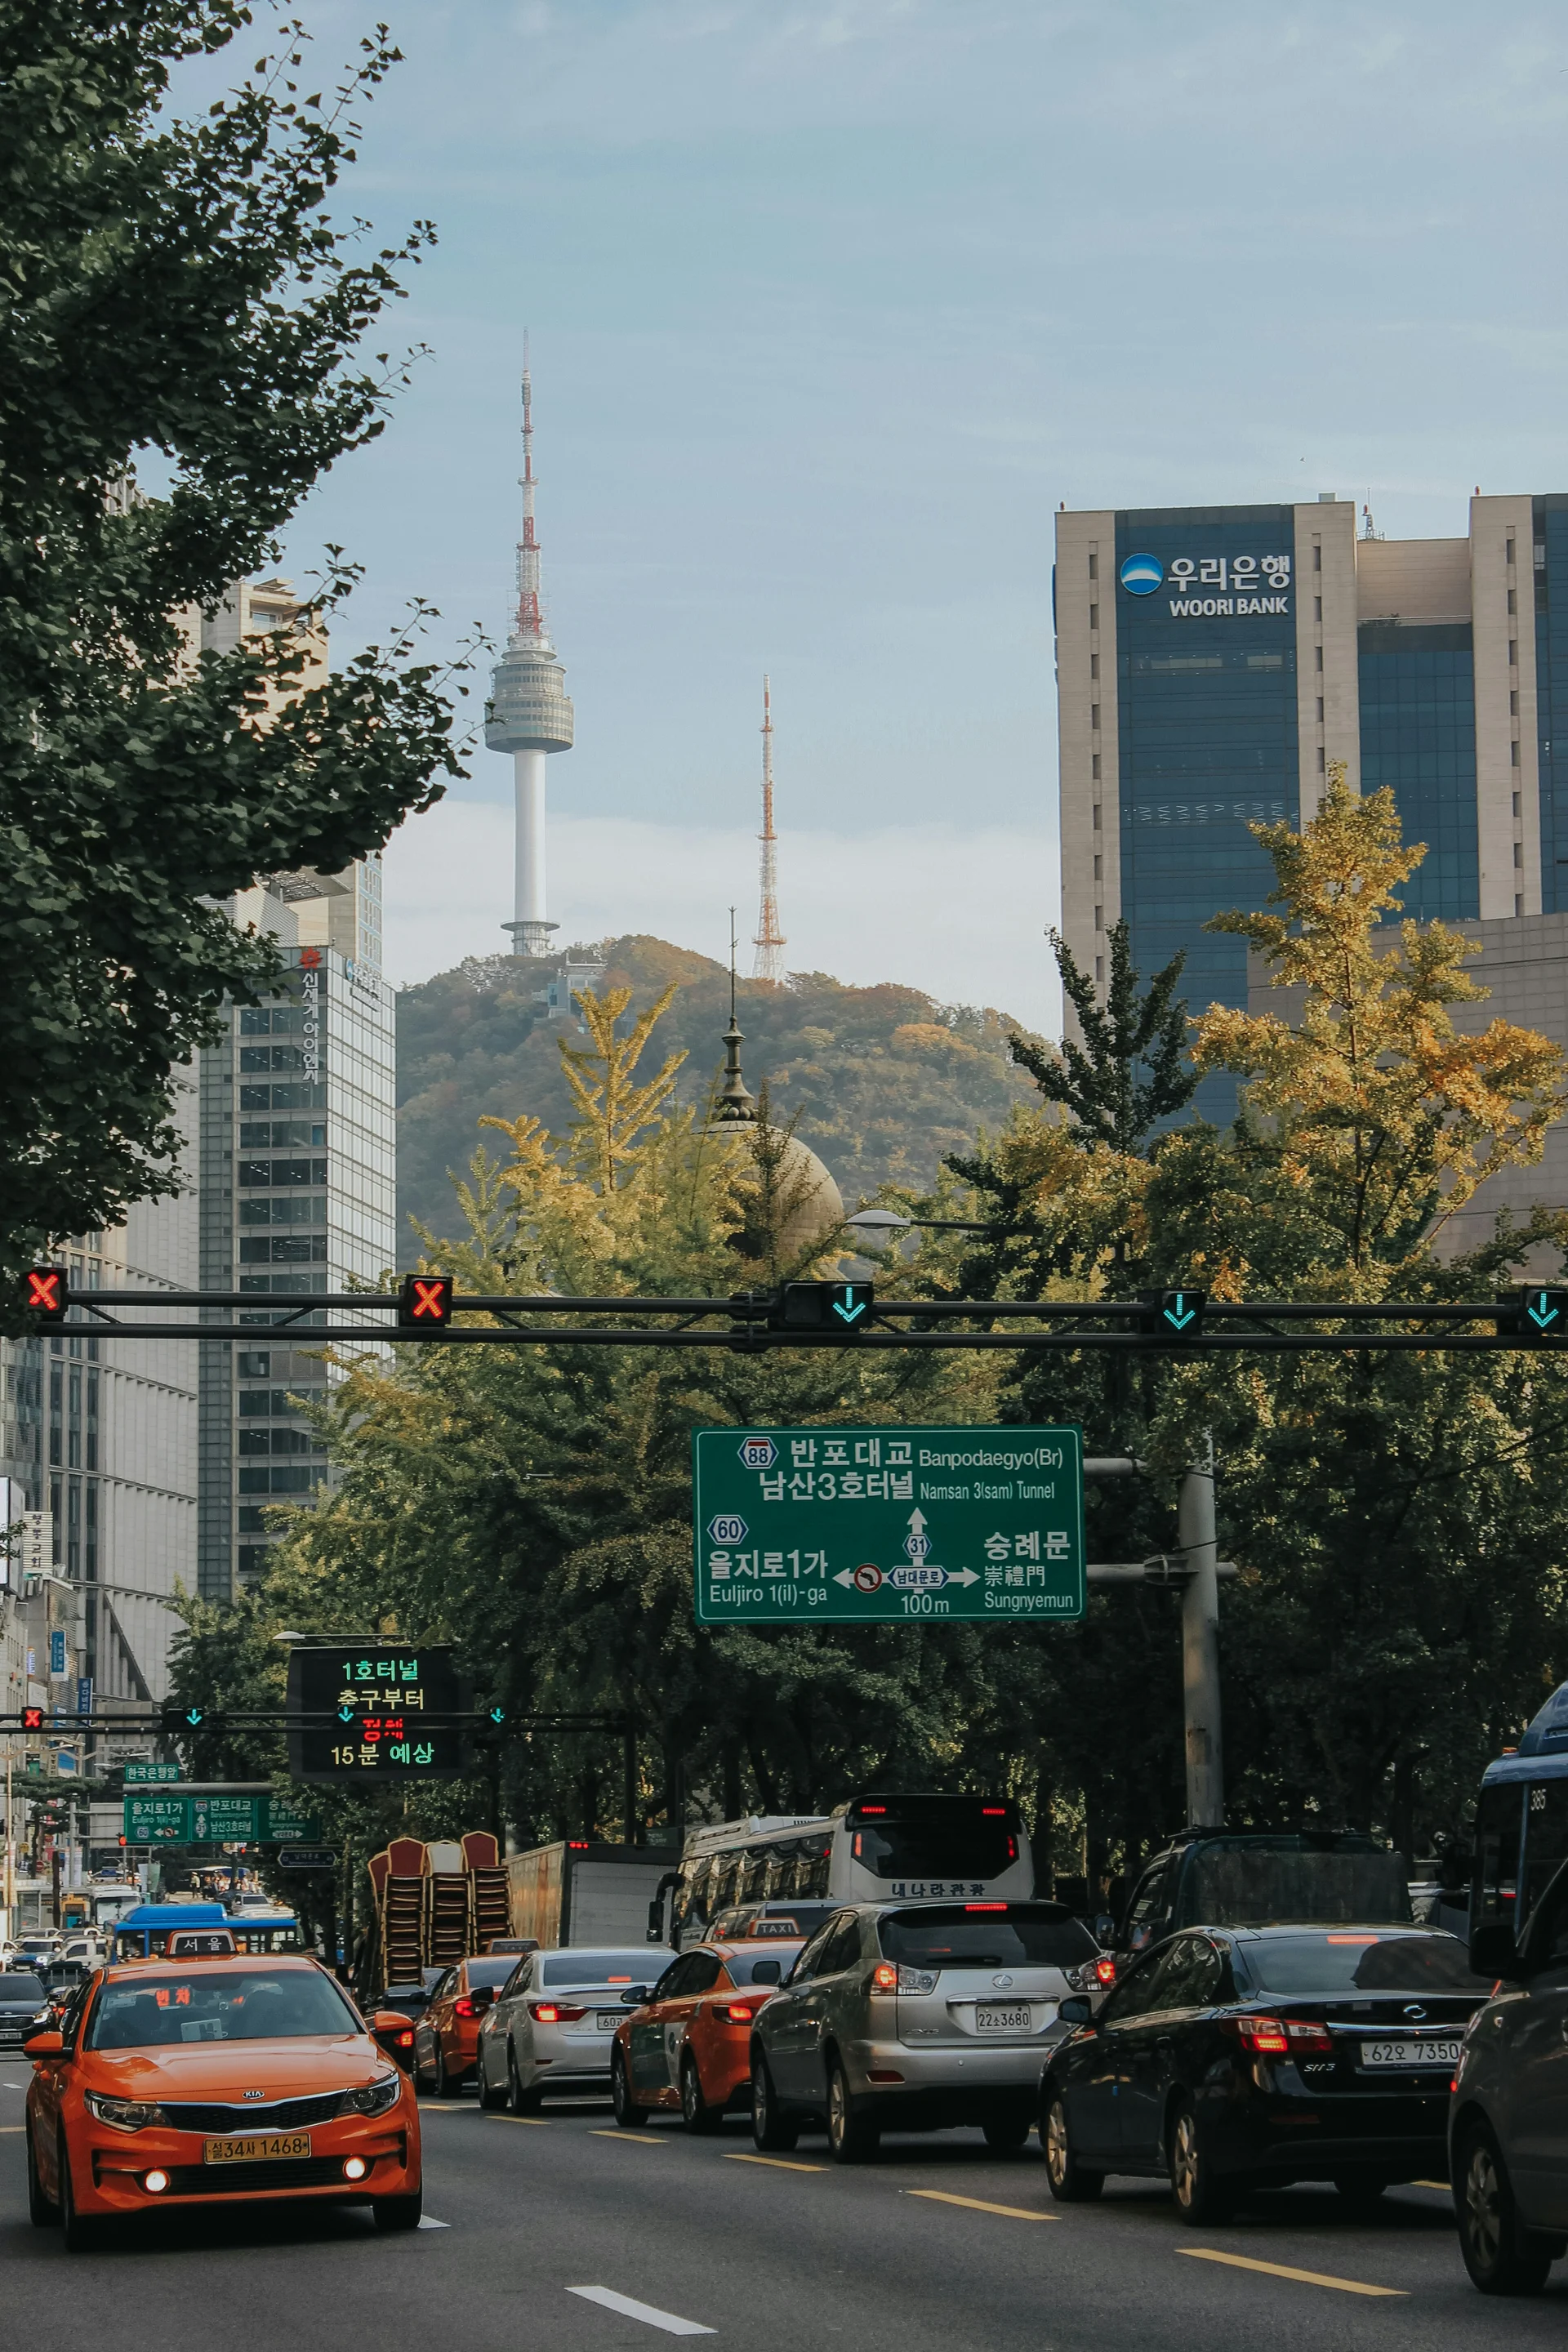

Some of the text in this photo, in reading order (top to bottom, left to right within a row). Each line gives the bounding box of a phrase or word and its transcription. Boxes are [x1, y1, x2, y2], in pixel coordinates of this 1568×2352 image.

[1168, 555, 1290, 592] 우리은행
[1169, 597, 1289, 617] WOORI BANK
[748, 1448, 768, 1463] 88
[791, 1438, 913, 1468] 반포대교
[919, 1447, 1062, 1470] Banpodaegyo(Br)
[760, 1471, 913, 1500] 남산3호터널
[920, 1481, 1055, 1499] Namsan 3(sam) Tunnel
[718, 1520, 739, 1539] 60
[911, 1538, 925, 1553] 31
[984, 1530, 1071, 1560] 숭례문
[708, 1549, 828, 1579] 을지로1가
[898, 1570, 940, 1584] 남대문로
[984, 1566, 1045, 1587] 崇禮門
[710, 1584, 764, 1607] Euljiro
[984, 1592, 1074, 1612] Sungnyemun
[342, 1659, 418, 1681] 1호터널
[390, 1742, 434, 1764] 예상
[127, 1766, 177, 1780] 한국은행앞
[131, 1802, 183, 1815] 을지로1가
[210, 1800, 252, 1811] 반포대교
[1530, 1788, 1546, 1811] 385
[210, 1820, 252, 1833] 남산3호터널
[761, 1925, 792, 1933] TAXI
[1414, 2043, 1459, 2060] 7350
[260, 2137, 302, 2156] 1468
